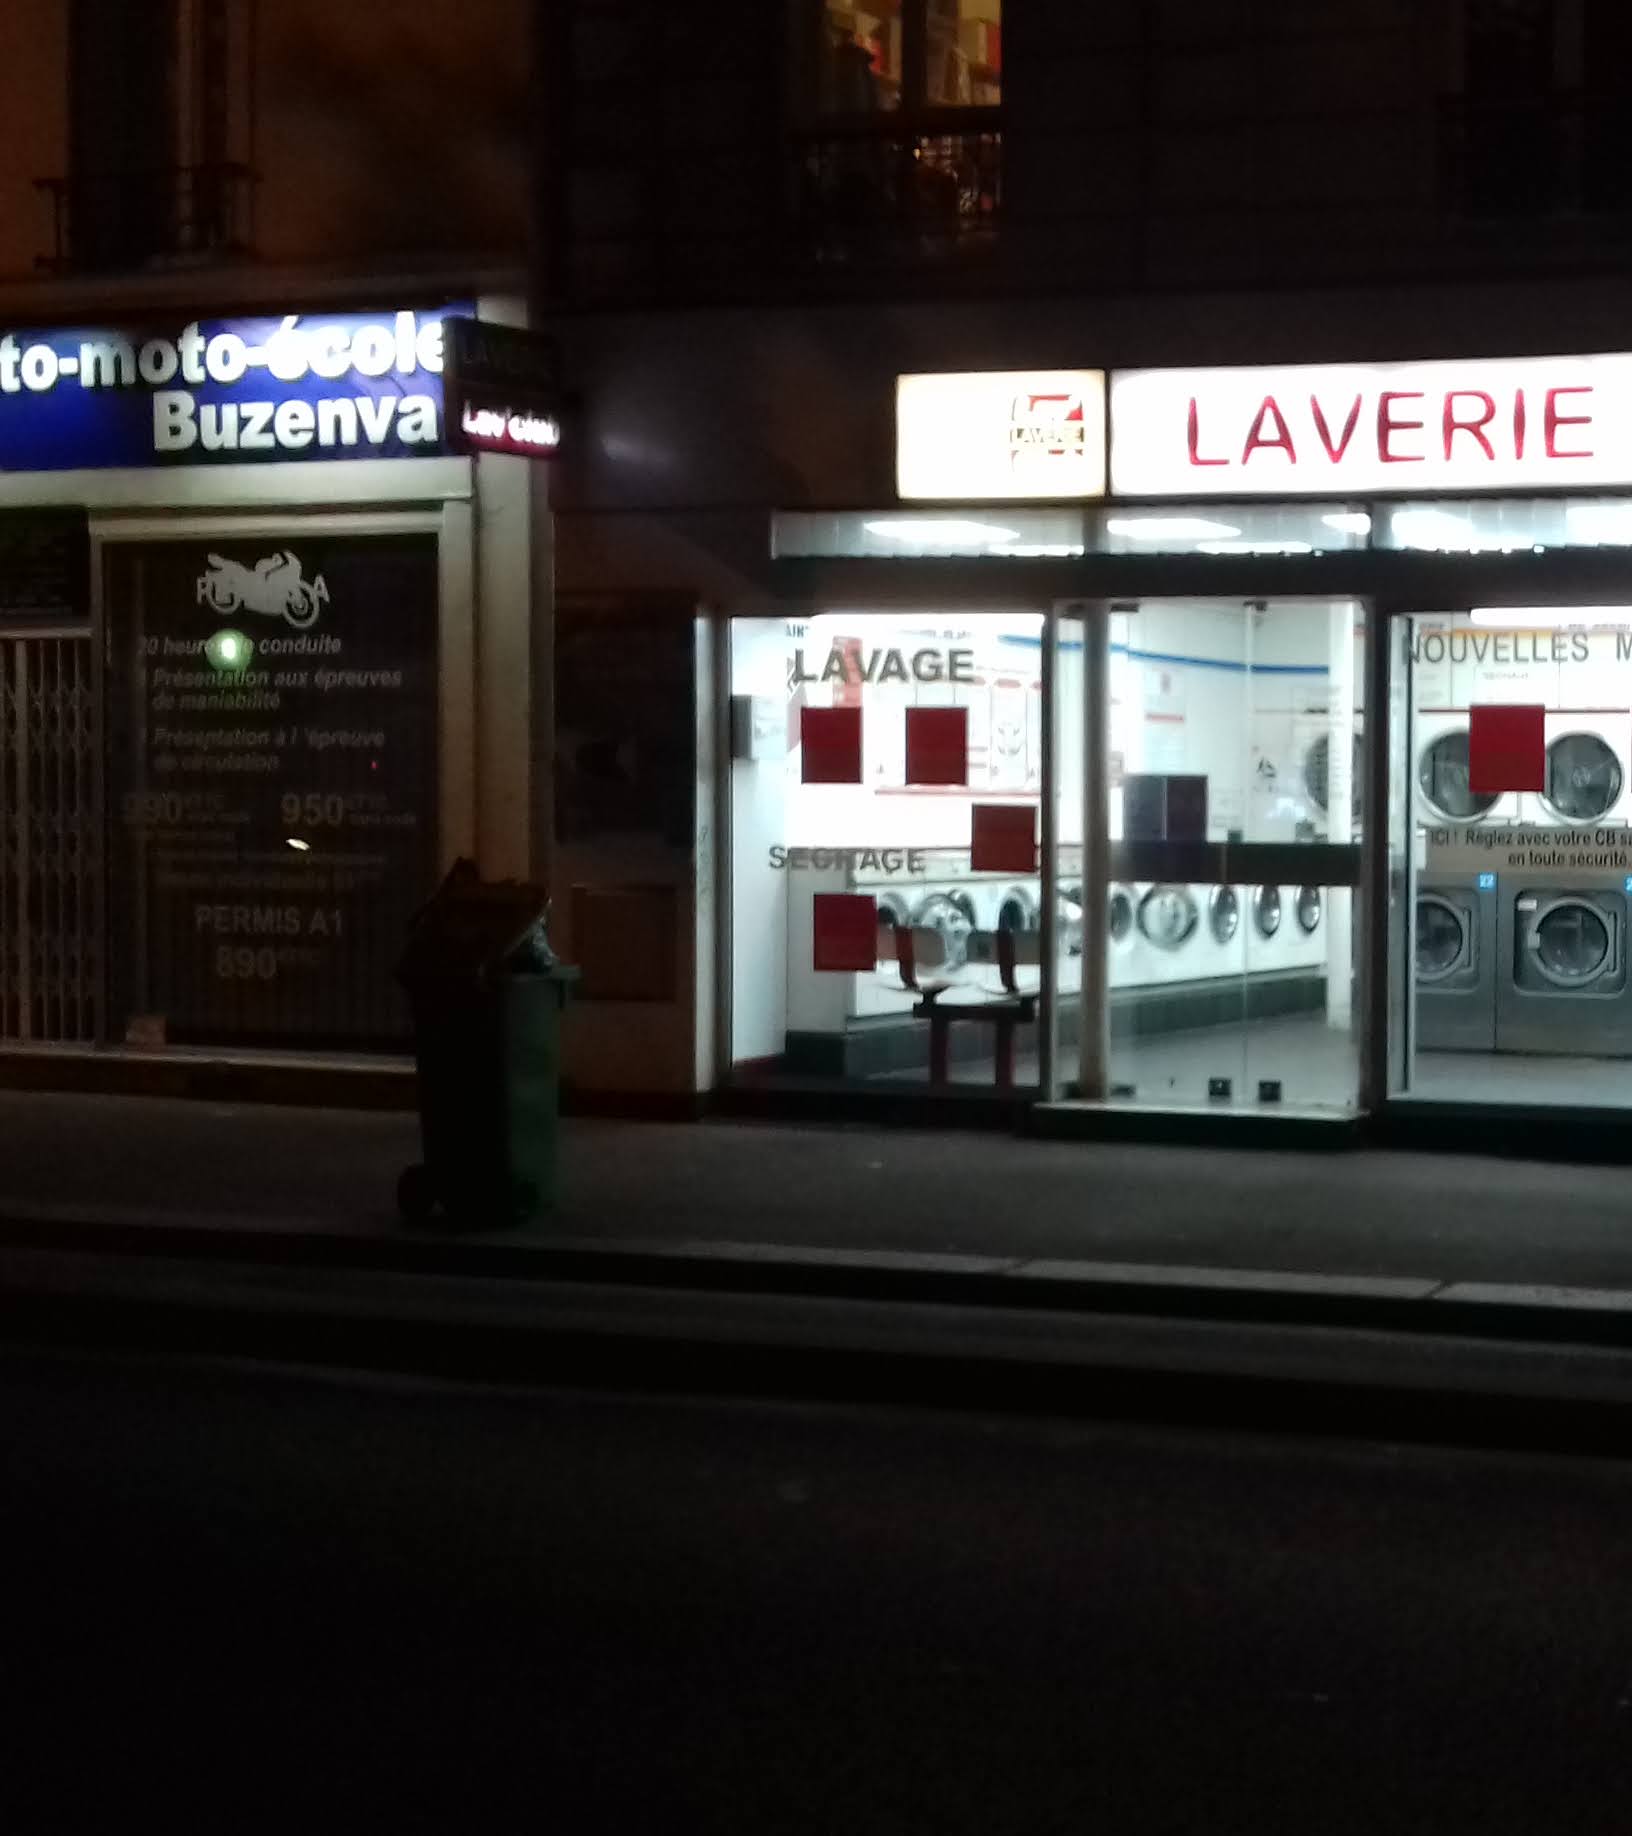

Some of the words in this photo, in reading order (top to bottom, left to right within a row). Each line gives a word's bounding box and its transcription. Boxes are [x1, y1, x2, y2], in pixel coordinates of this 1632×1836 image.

[1186, 386, 1594, 466] LAVERIE
[259, 633, 341, 655] conduite
[1404, 631, 1590, 664] NOUVELLES
[794, 648, 975, 683] LAVAGE
[281, 792, 345, 825] 950
[1517, 831, 1550, 845] avec
[1554, 830, 1591, 846] votre
[1595, 829, 1616, 846] CB
[1508, 853, 1525, 867] en
[1529, 850, 1566, 867] toute
[195, 904, 302, 936] PERMIS
[309, 906, 344, 936] A1
